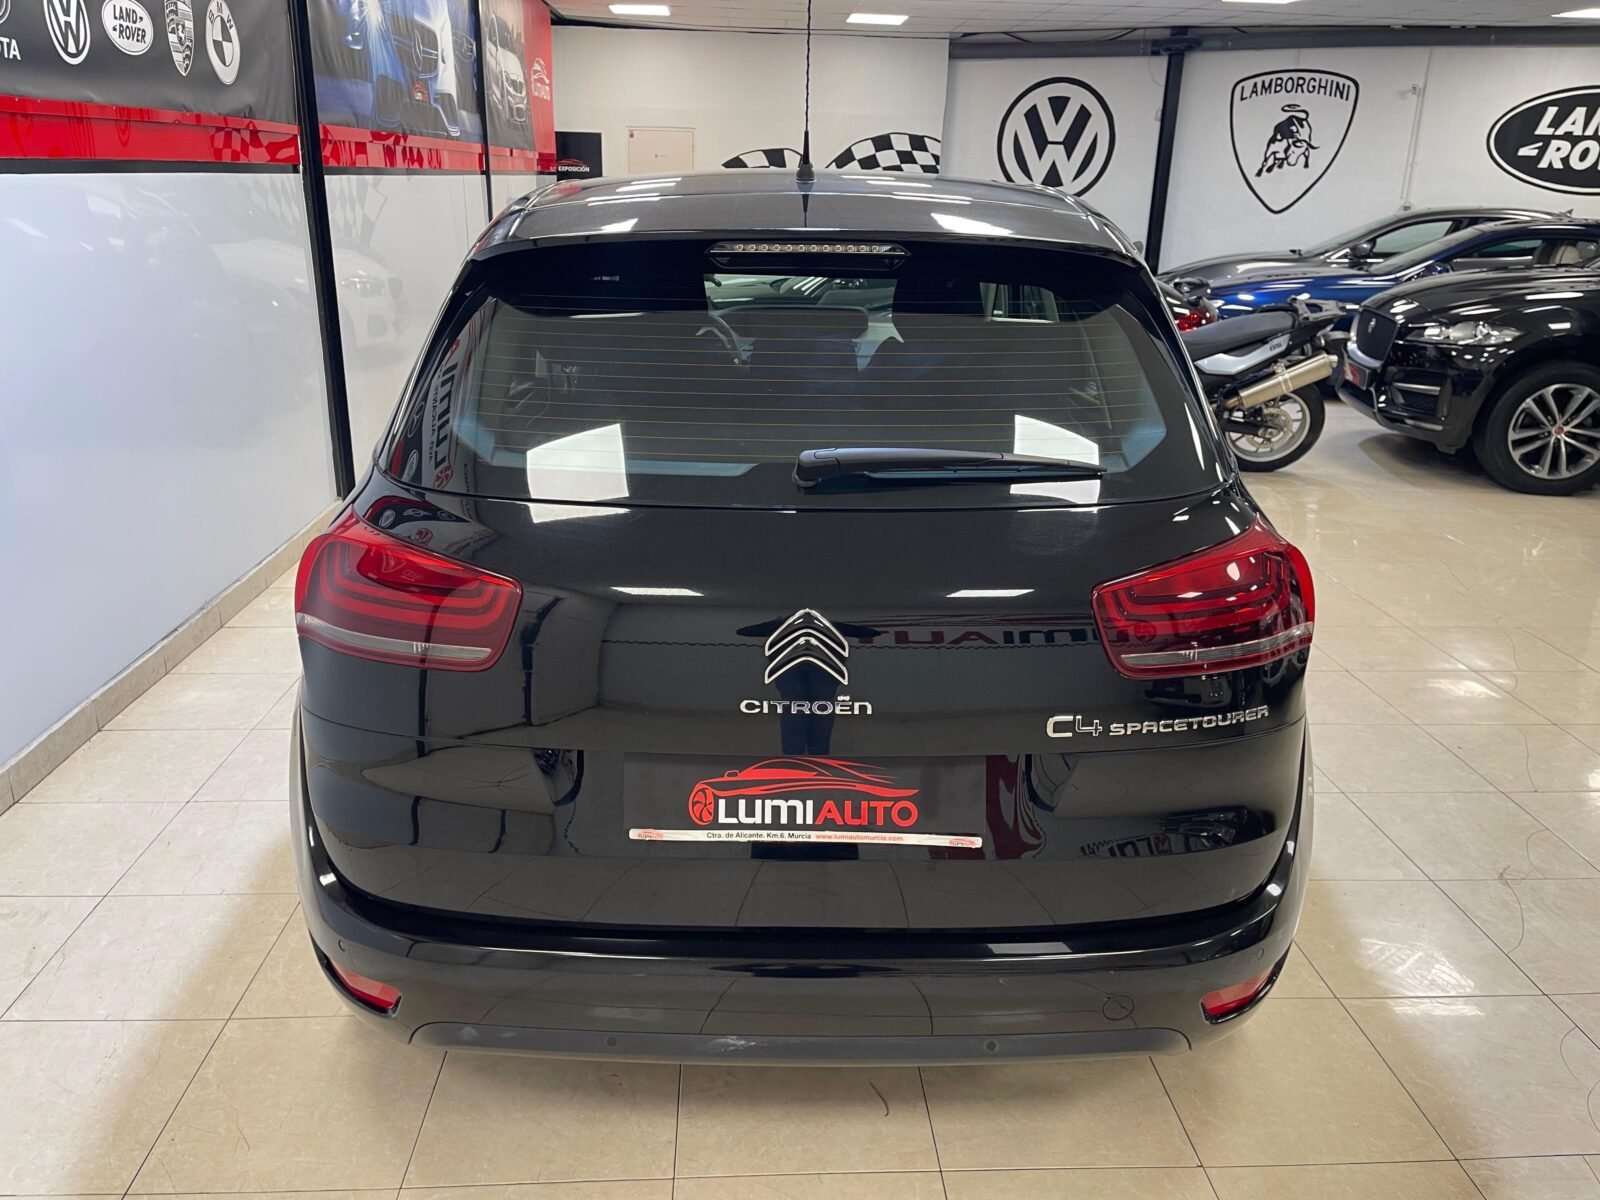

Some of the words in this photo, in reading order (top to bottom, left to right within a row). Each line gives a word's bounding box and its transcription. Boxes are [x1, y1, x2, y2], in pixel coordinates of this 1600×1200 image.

[113, 4, 138, 24] LAND
[118, 23, 146, 44] ROVER
[0, 36, 21, 60] TA
[1239, 76, 1351, 102] LAMBORGHINI
[1537, 139, 1600, 171] RO
[1046, 715, 1103, 738] C4
[1109, 705, 1269, 736] SPACETOURER
[788, 832, 812, 840] Murcia
[815, 833, 904, 842] www.lumiautomurcia.com
